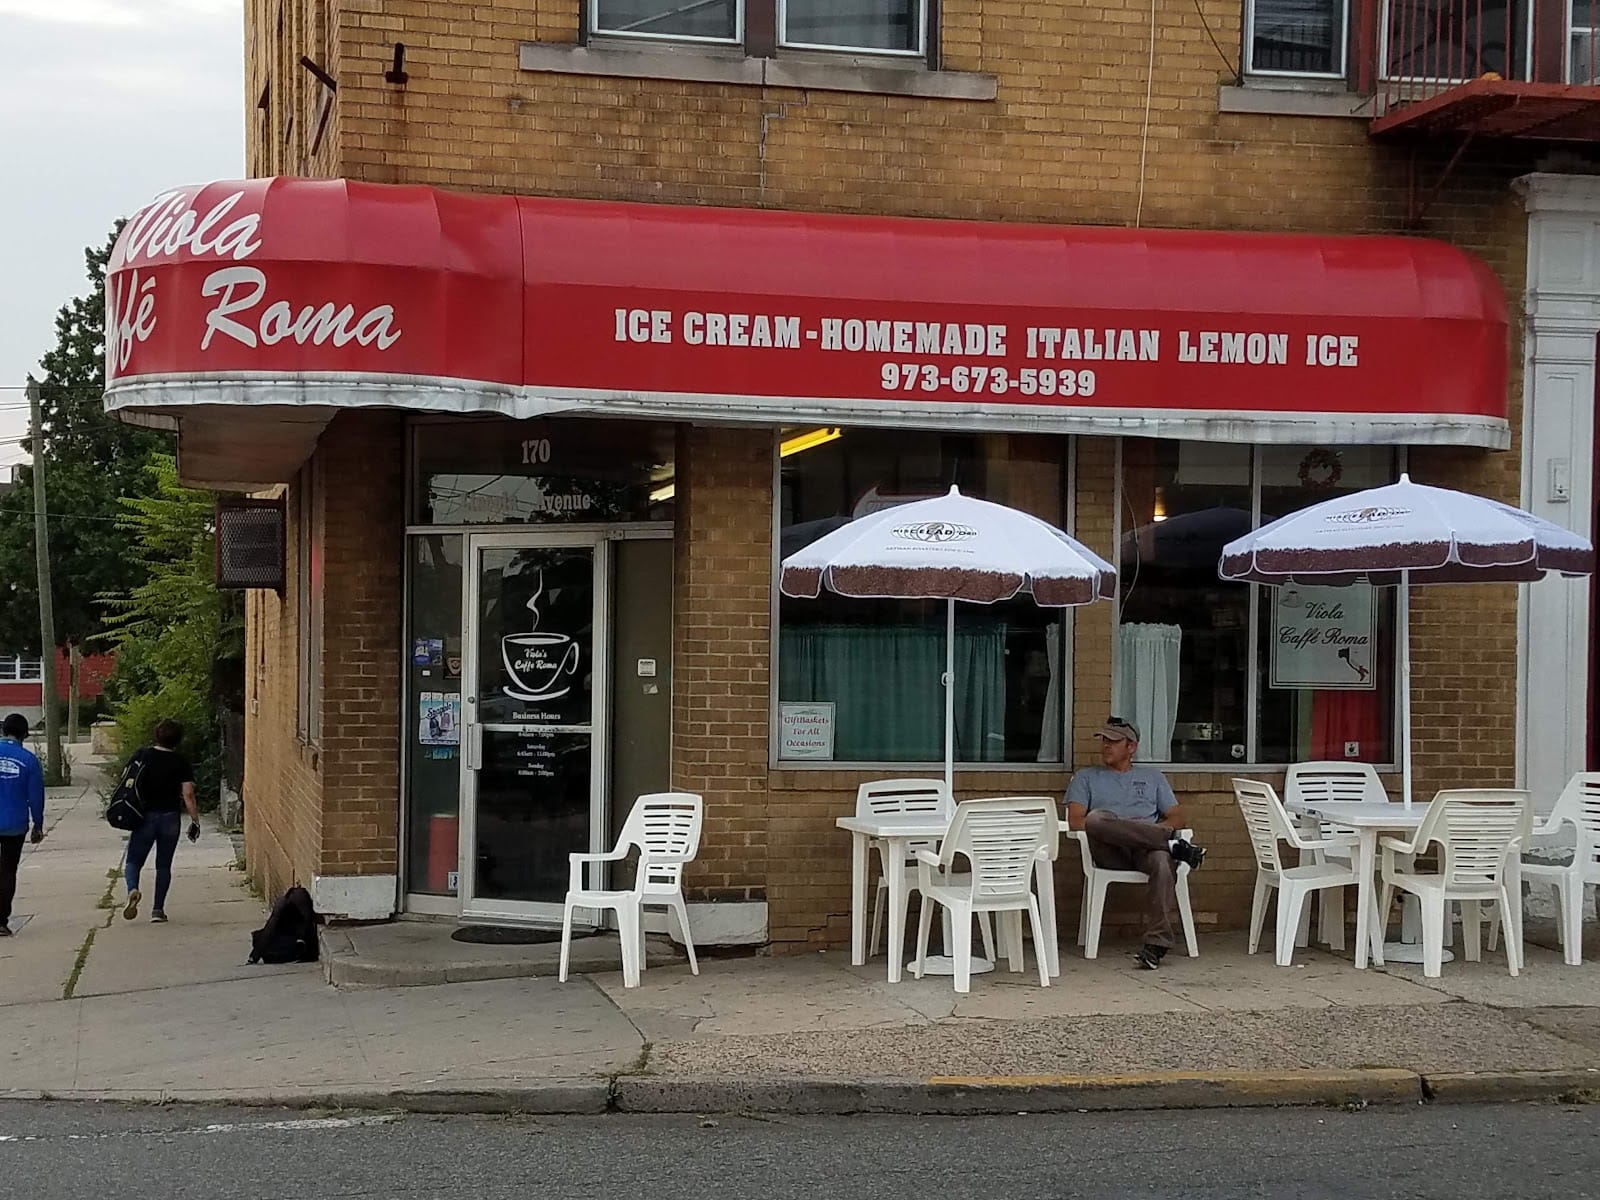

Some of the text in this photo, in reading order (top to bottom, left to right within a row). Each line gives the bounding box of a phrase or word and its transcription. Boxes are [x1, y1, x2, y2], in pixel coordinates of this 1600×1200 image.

[123, 189, 262, 262] Viola
[201, 265, 402, 351] Roma
[614, 309, 672, 344] ICE
[1026, 326, 1160, 361] ITALIAN
[1178, 330, 1288, 365] LEMON
[1306, 334, 1359, 367] ICE
[881, 362, 1096, 397] 973-673-5939
[521, 438, 551, 464] 170
[538, 493, 592, 511] Avenue
[1305, 601, 1345, 619] Viola
[1321, 627, 1369, 645] Roma
[512, 711, 561, 720] Business Hours
[807, 727, 820, 736] All
[786, 739, 825, 747] Occasions
